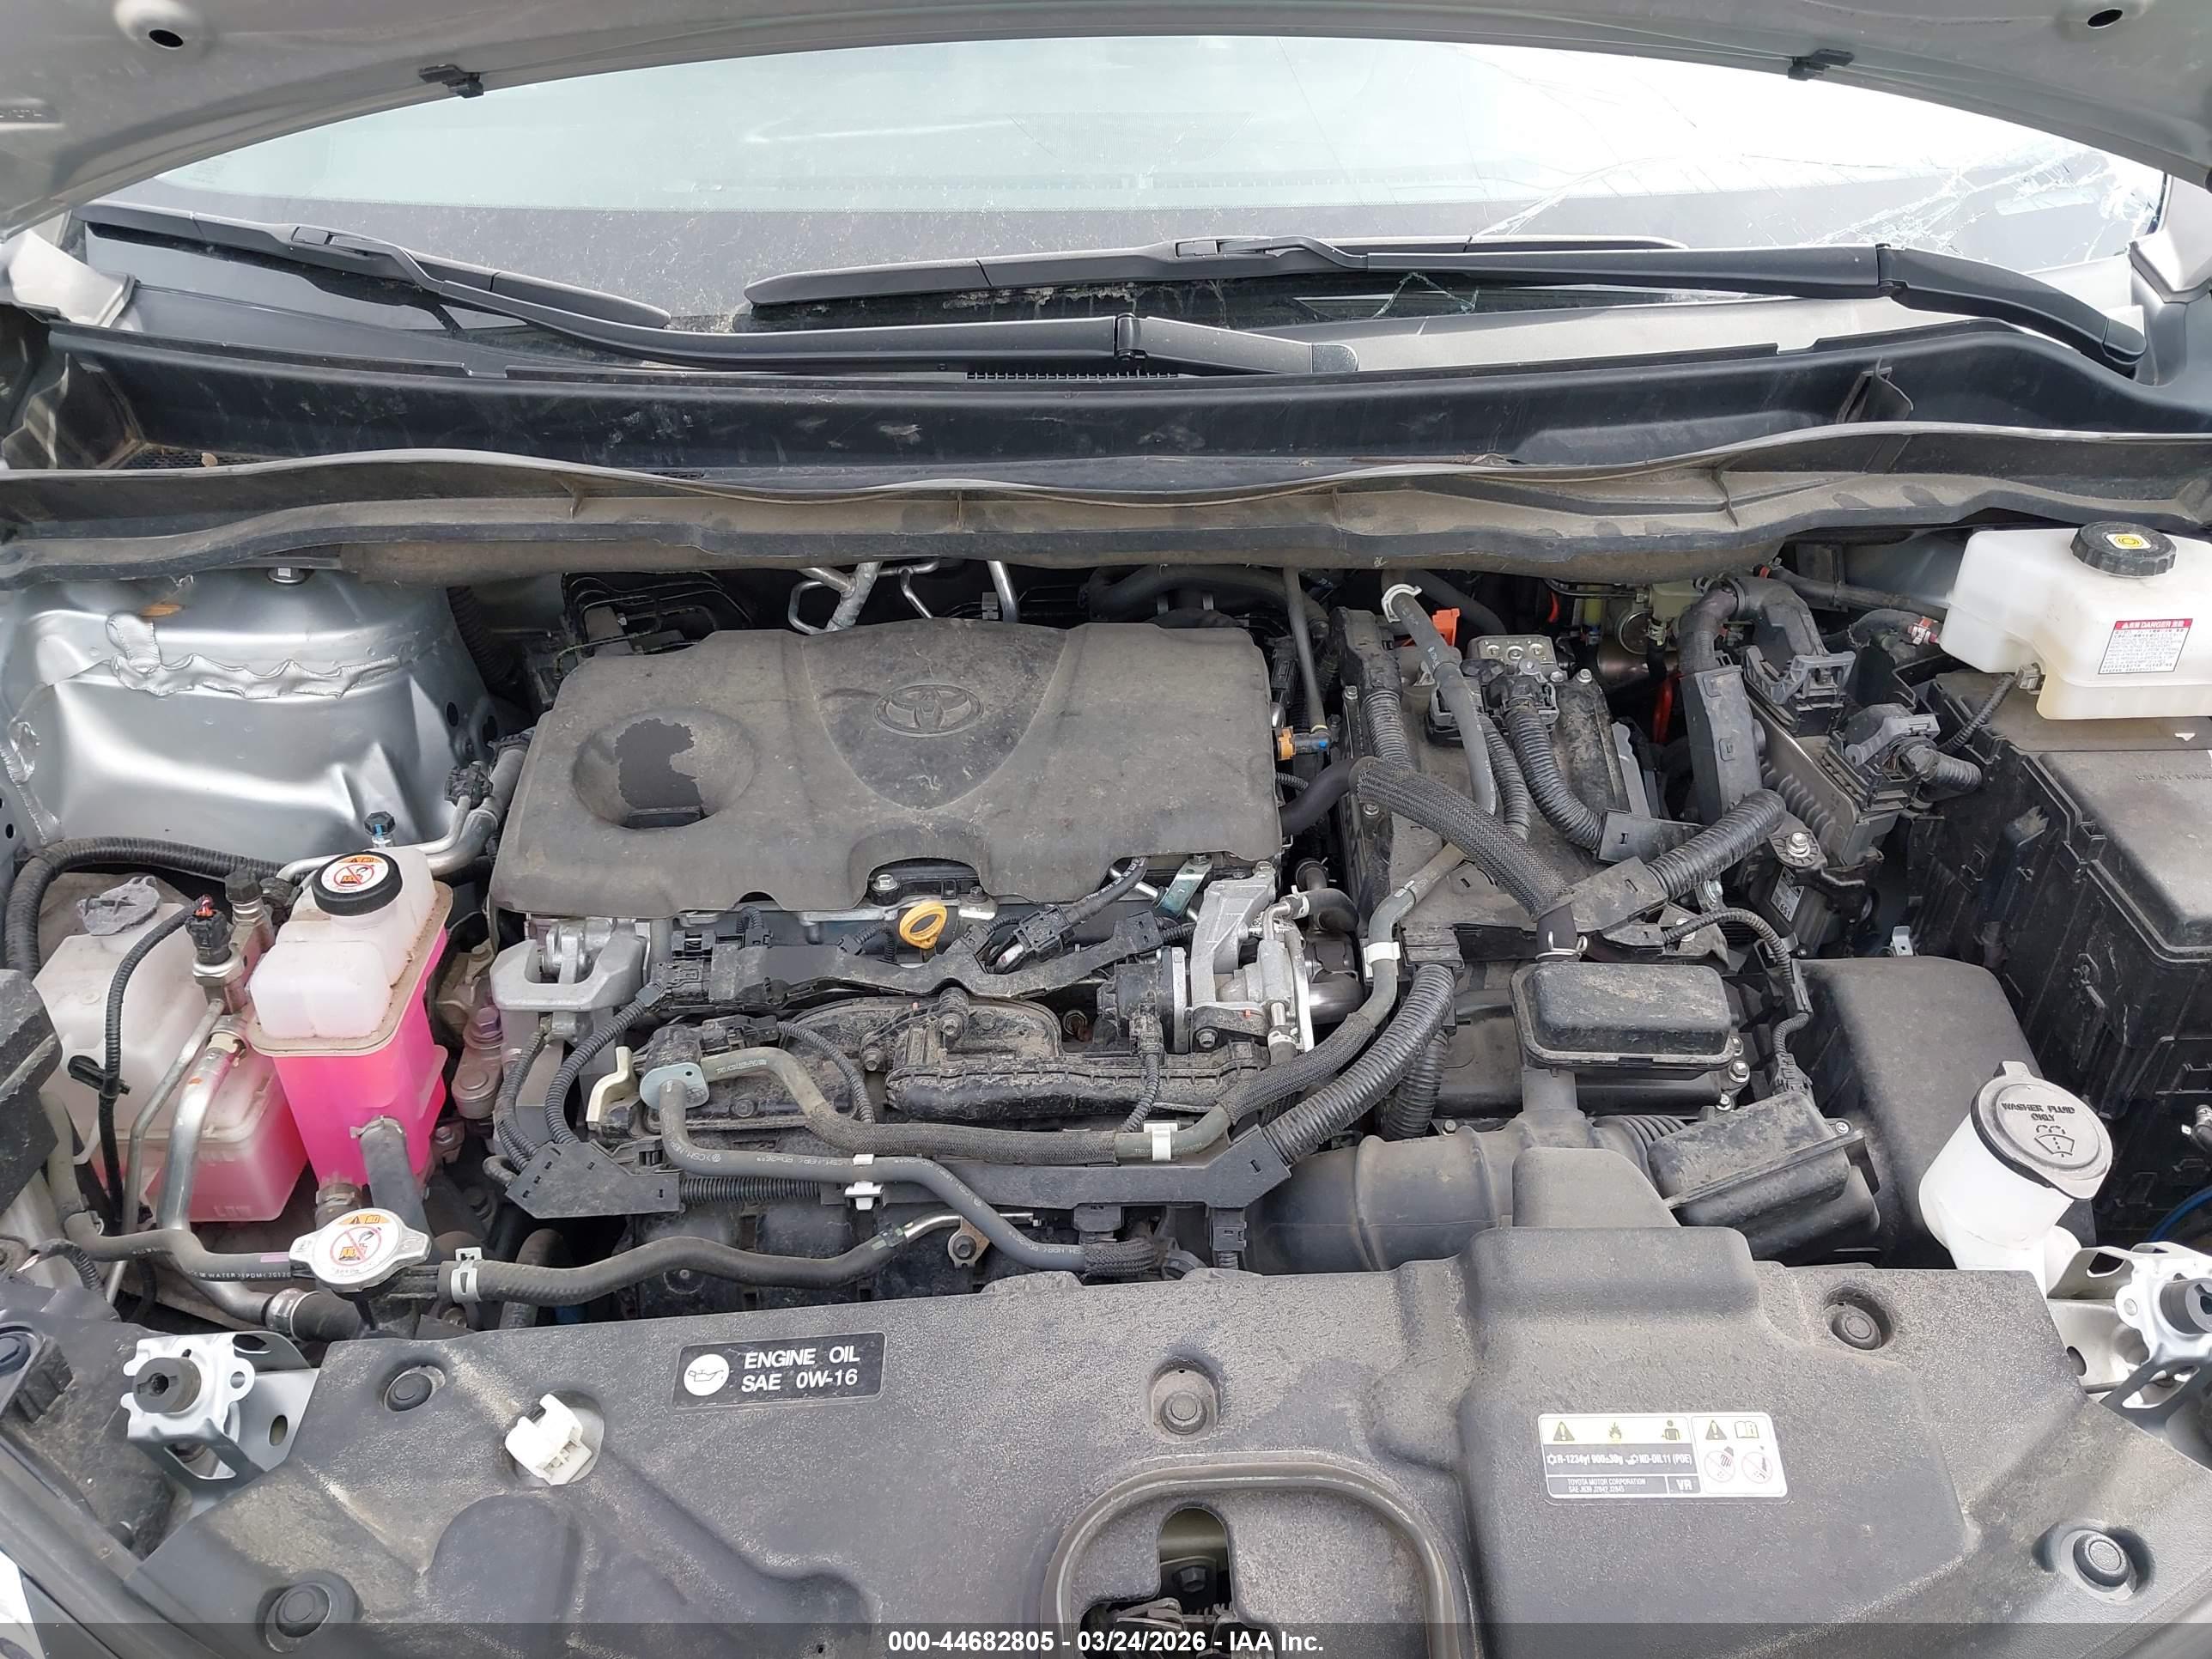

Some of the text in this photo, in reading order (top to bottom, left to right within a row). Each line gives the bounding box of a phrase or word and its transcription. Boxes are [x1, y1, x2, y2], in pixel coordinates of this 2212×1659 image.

[2001, 1103, 2075, 1114] WASHER FLUID
[2031, 1113, 2055, 1121] ONLY
[744, 1346, 860, 1370] ENGINE OIL
[741, 1369, 858, 1392] SAE 0W-16
[1676, 1479, 1692, 1491] VR
